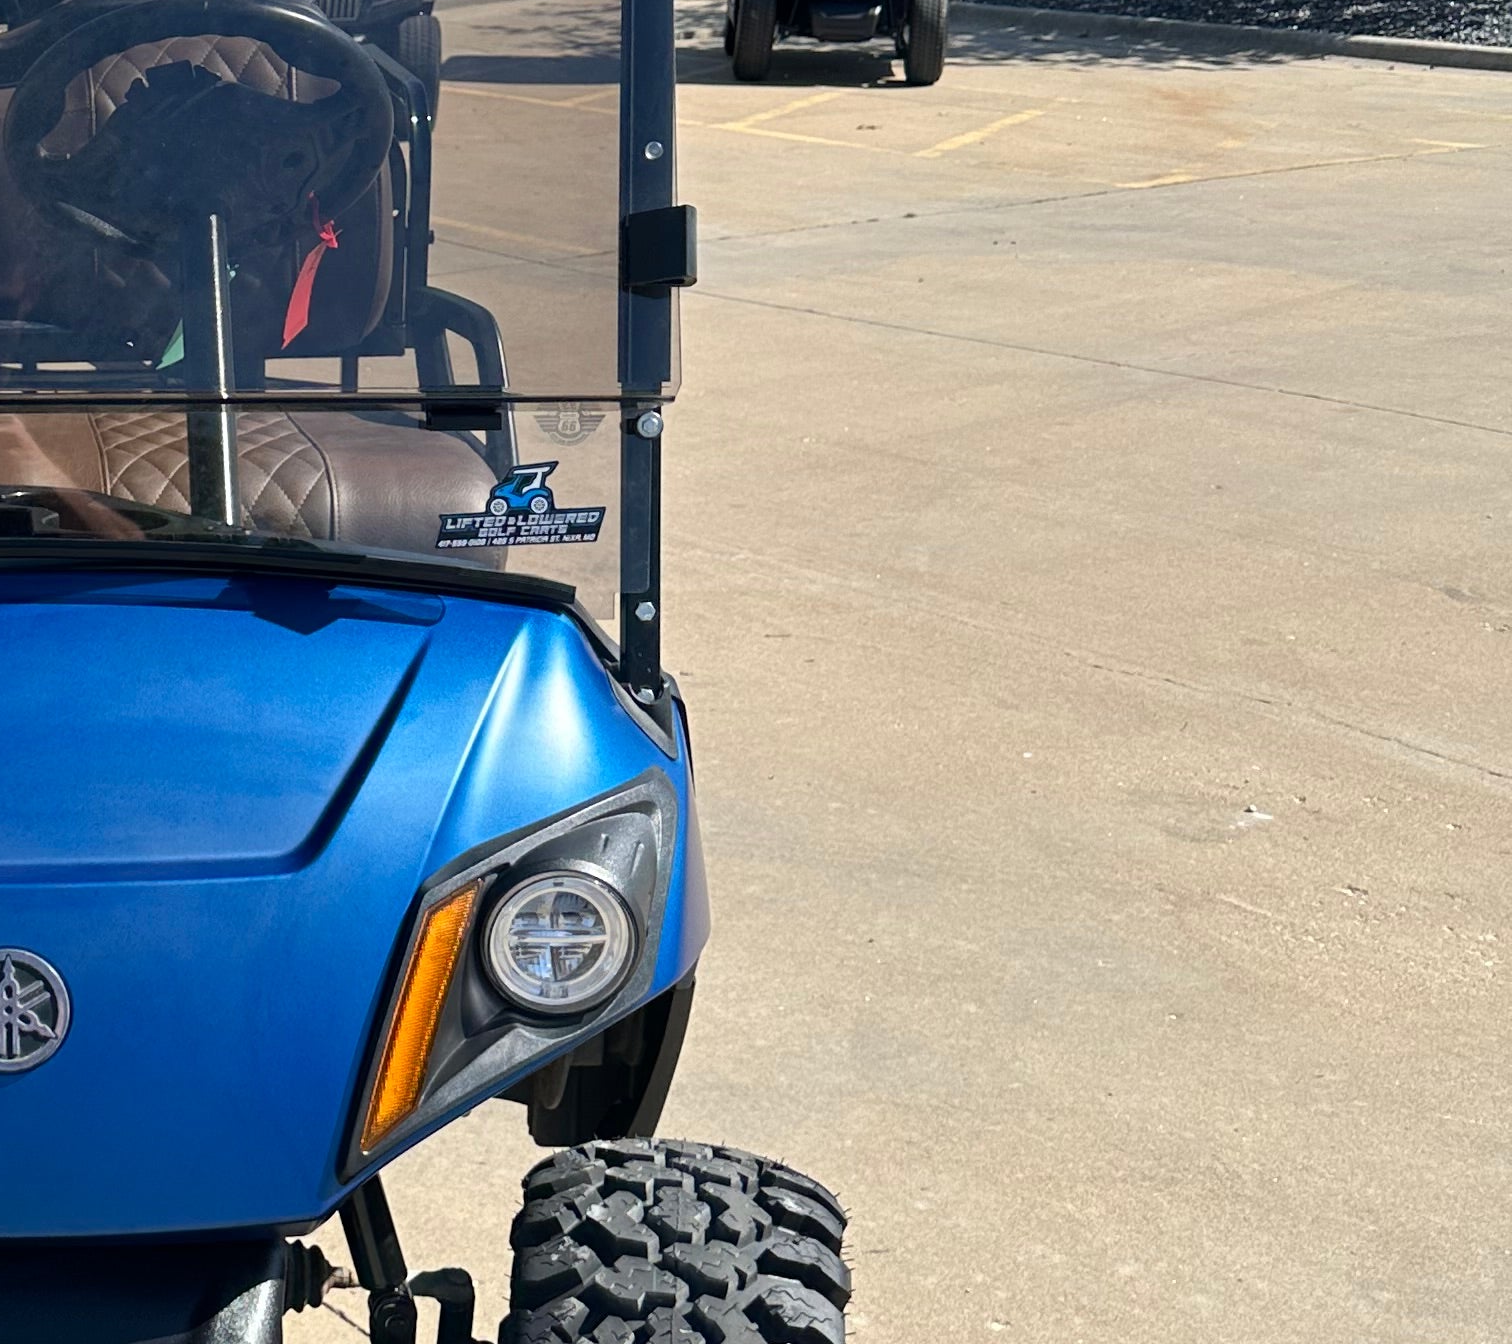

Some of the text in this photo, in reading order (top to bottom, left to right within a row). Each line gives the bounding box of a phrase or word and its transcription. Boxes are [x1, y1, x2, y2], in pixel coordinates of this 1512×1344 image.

[445, 515, 506, 530] LIFTED
[516, 511, 600, 526] LOWERED
[477, 524, 569, 538] GOLF CARTS
